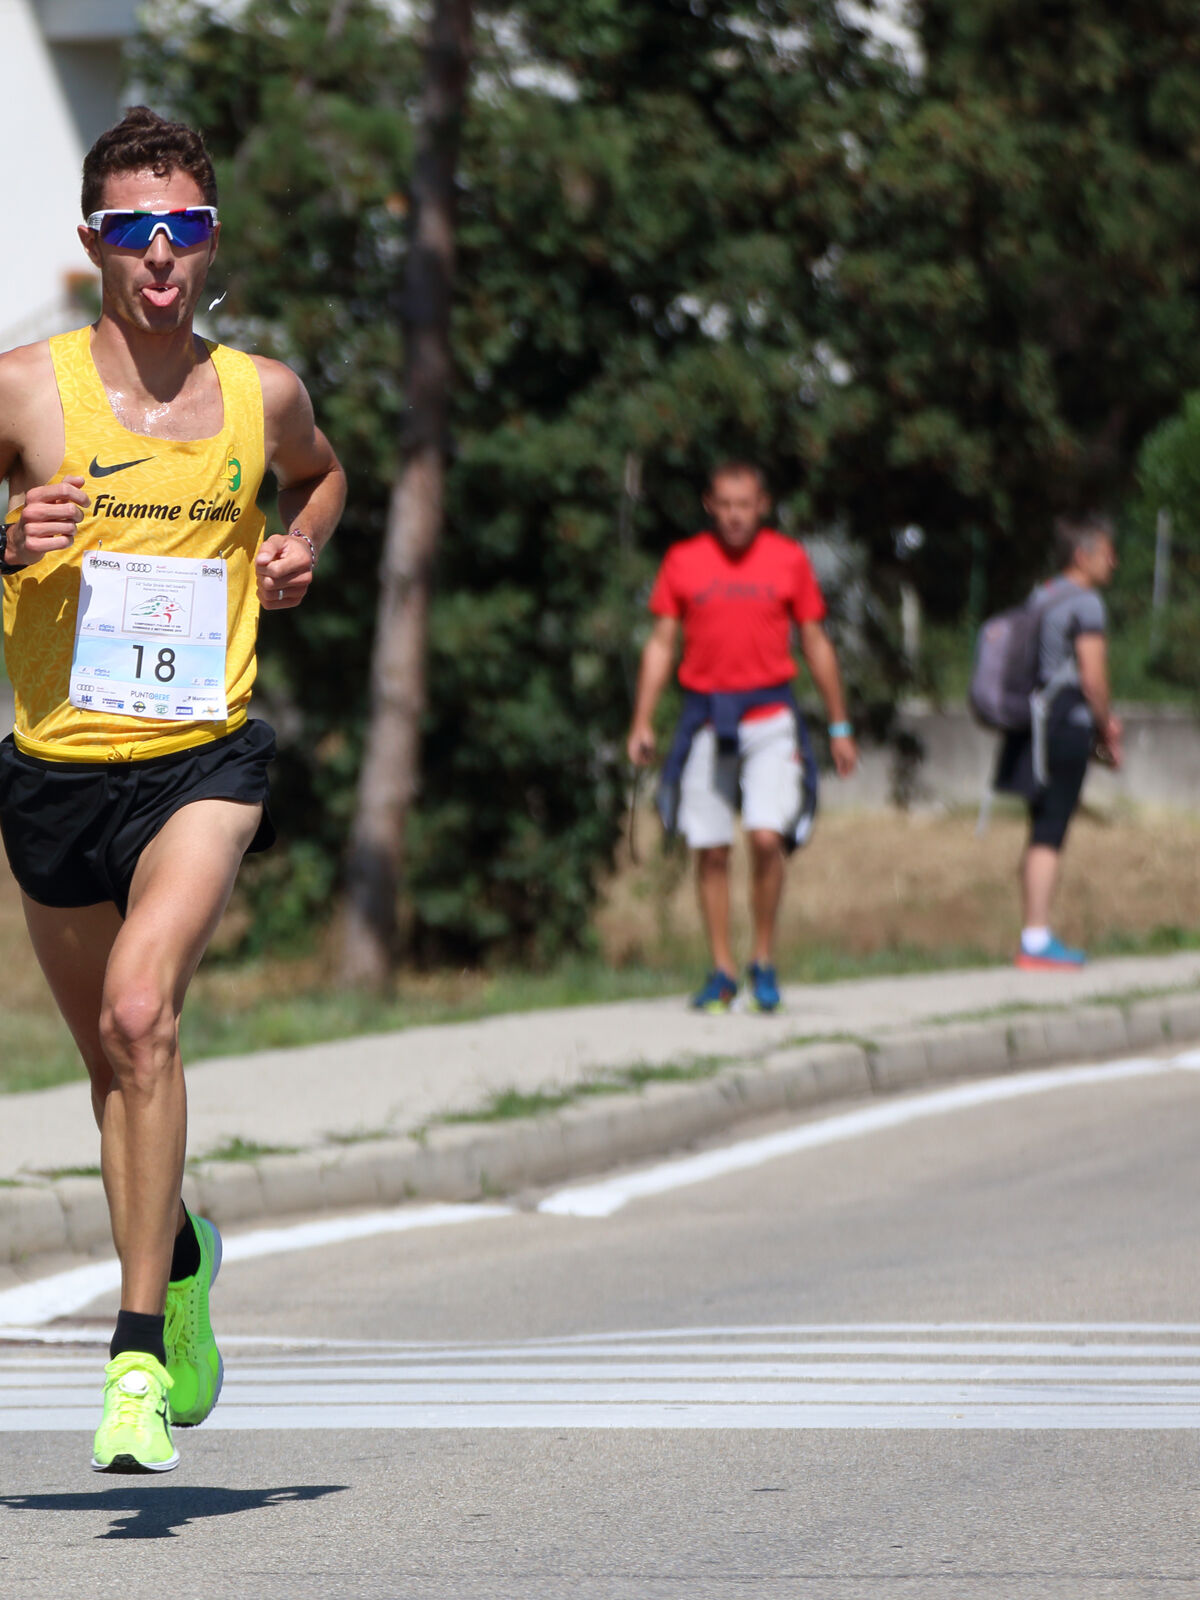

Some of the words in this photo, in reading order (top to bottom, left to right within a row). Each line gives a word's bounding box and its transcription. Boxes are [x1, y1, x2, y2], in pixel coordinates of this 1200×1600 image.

[92, 494, 182, 521] Fiamme
[188, 498, 241, 523] Gialle
[89, 558, 120, 568] BOSCA
[132, 644, 176, 683] 18
